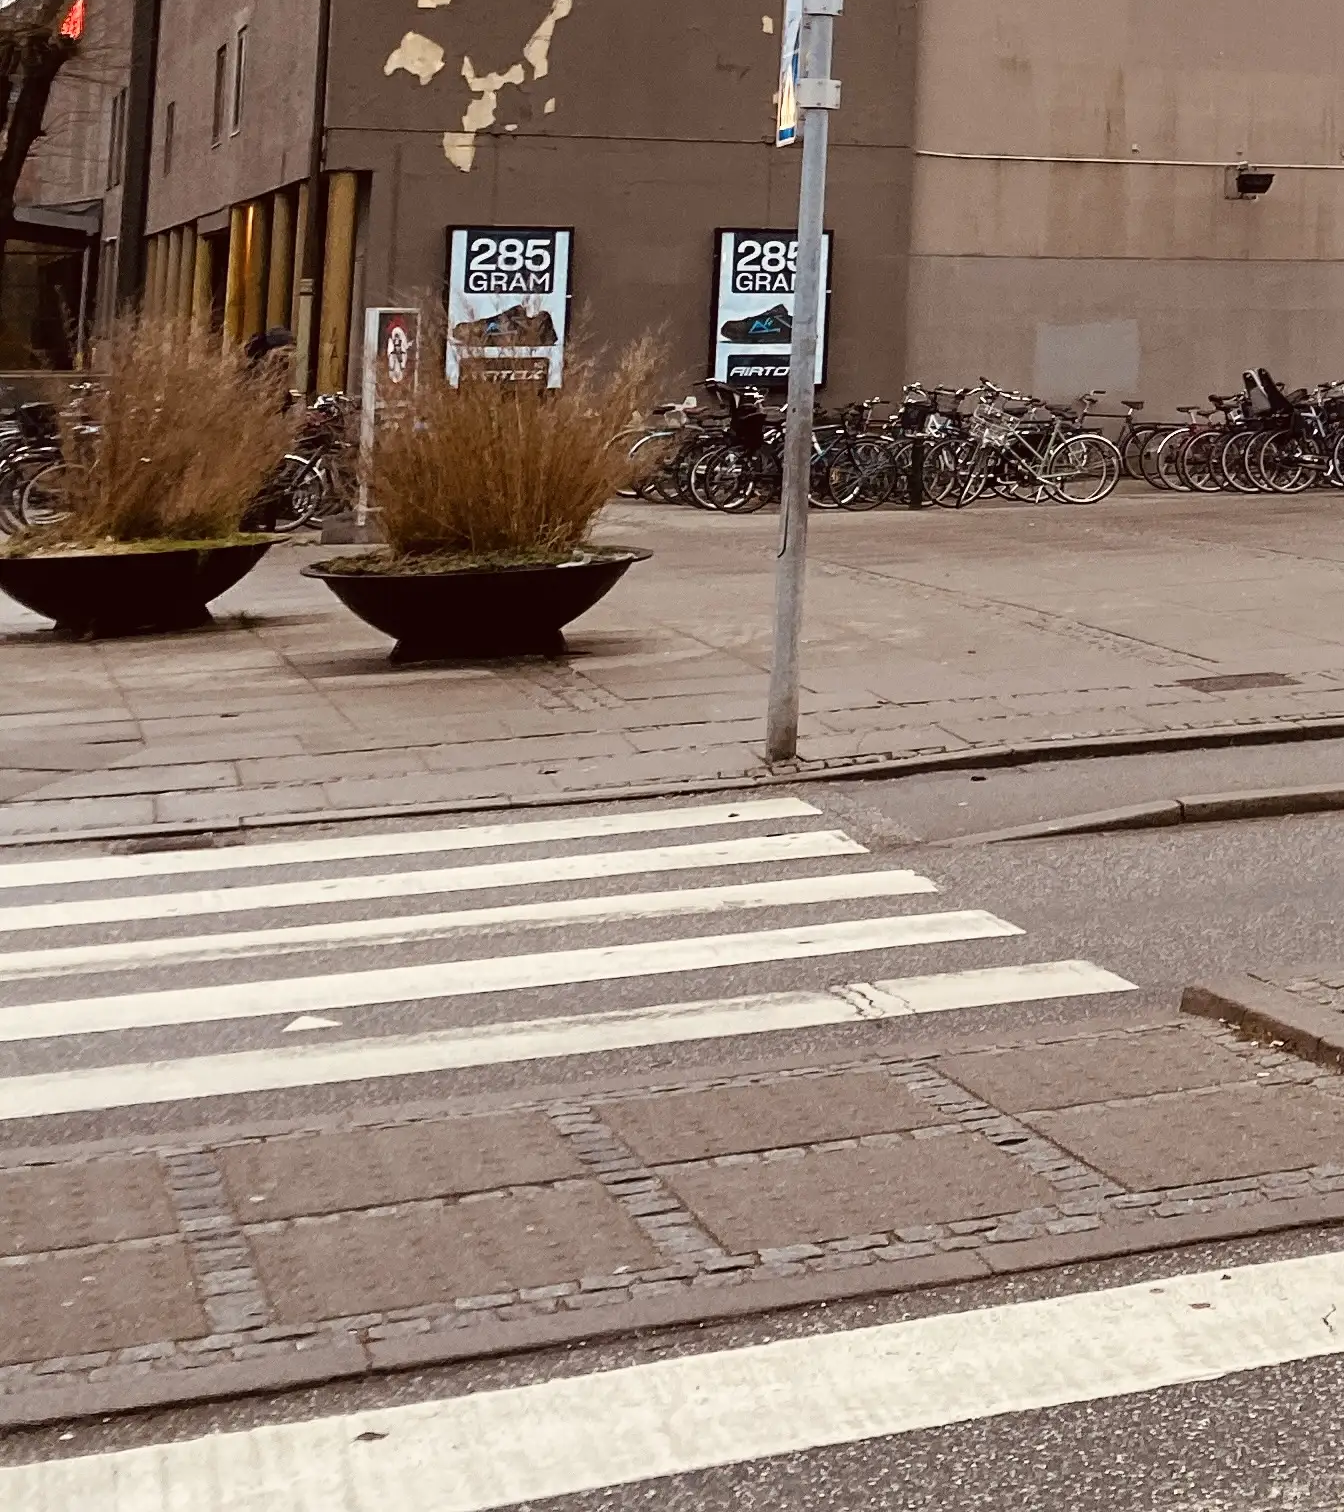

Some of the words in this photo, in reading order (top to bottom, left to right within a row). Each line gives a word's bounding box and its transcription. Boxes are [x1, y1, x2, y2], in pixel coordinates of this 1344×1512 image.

[470, 238, 551, 272] 285
[469, 272, 550, 291] GRAM
[735, 273, 797, 292] GRA
[729, 366, 790, 377] AIRTO
